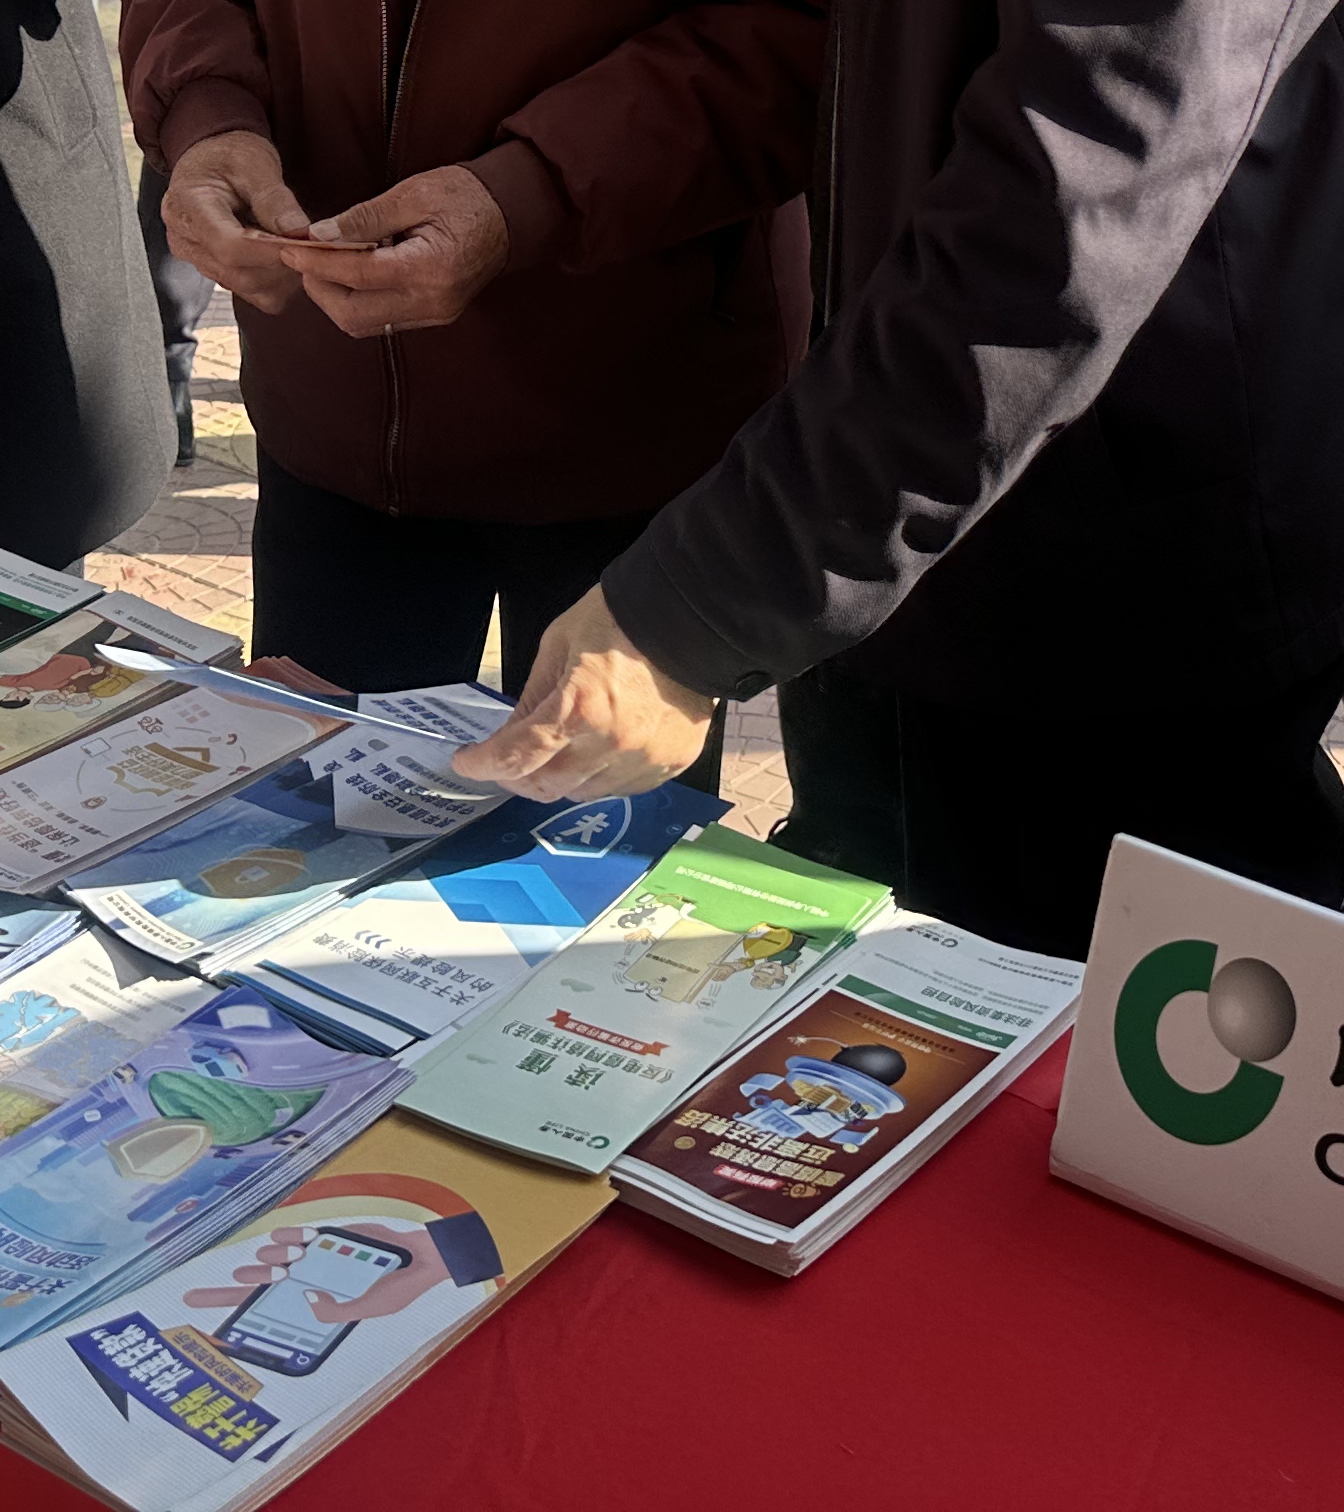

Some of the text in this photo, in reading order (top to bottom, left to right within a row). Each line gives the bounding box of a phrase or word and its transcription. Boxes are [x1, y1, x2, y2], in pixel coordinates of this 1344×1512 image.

[310, 931, 476, 1007] 关于互联网保险消费
[388, 945, 496, 993] 的风险提示
[918, 985, 1035, 1029] 非法集资风险自担
[498, 1018, 678, 1084] 《反电信网络诈骗法》
[513, 1047, 608, 1090] 读懂
[536, 1123, 587, 1143] 中国人寿
[673, 1107, 836, 1164] 远离非法集资
[706, 1140, 845, 1188] 警惕高息诱惑
[86, 1322, 269, 1453] 关于警惕“快速贷款”
[169, 1331, 256, 1394] 诈骗的风险提示
